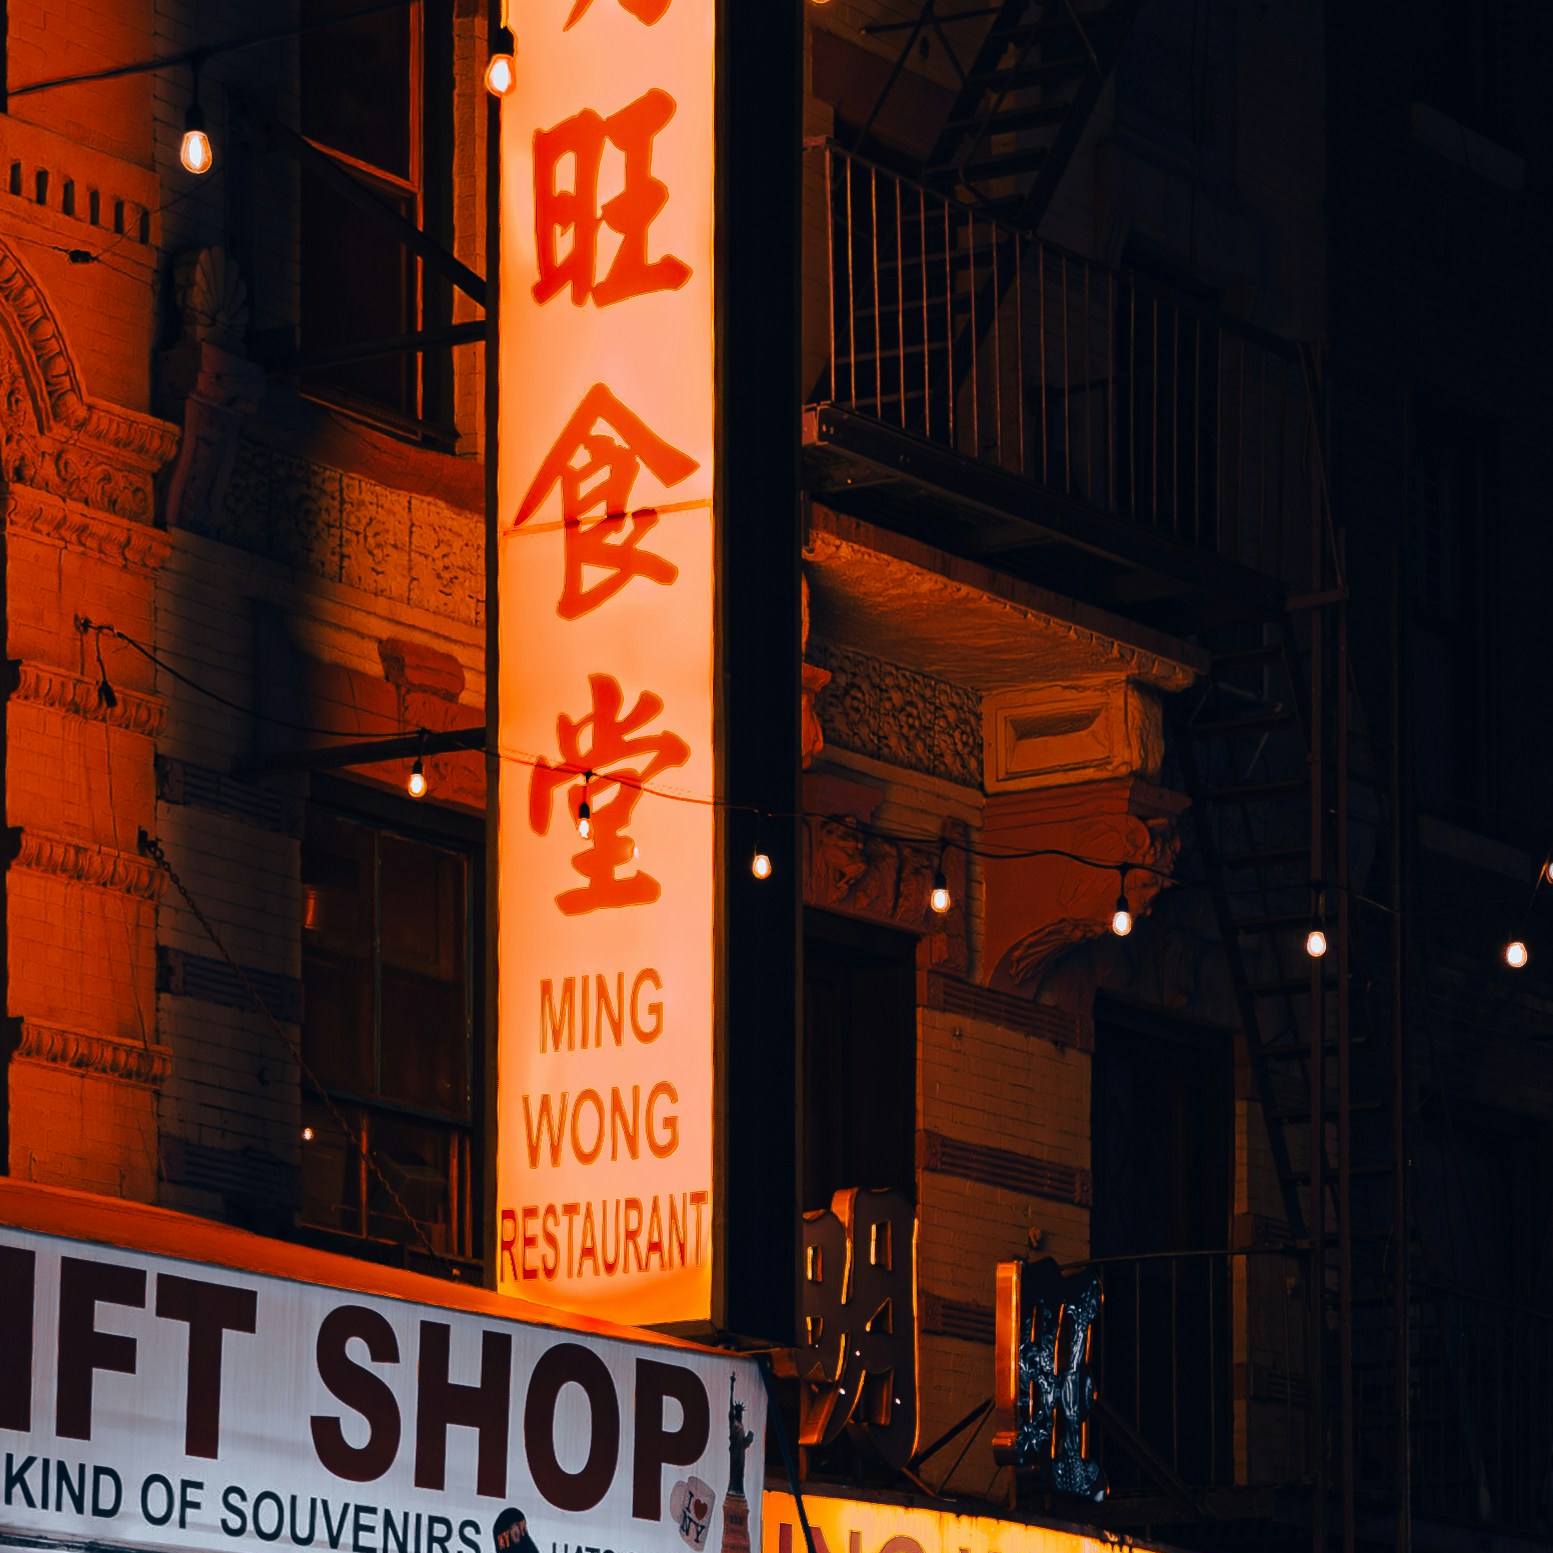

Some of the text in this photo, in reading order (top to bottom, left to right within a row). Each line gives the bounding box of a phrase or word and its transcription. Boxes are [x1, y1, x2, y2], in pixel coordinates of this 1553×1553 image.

[539, 967, 665, 1055] MING
[522, 1081, 680, 1169] WONG
[500, 1190, 709, 1284] RESTAURANT
[310, 1305, 710, 1522] SHOP
[4, 1452, 123, 1518] KIND
[140, 1473, 205, 1529] OF
[680, 1509, 706, 1543] NY
